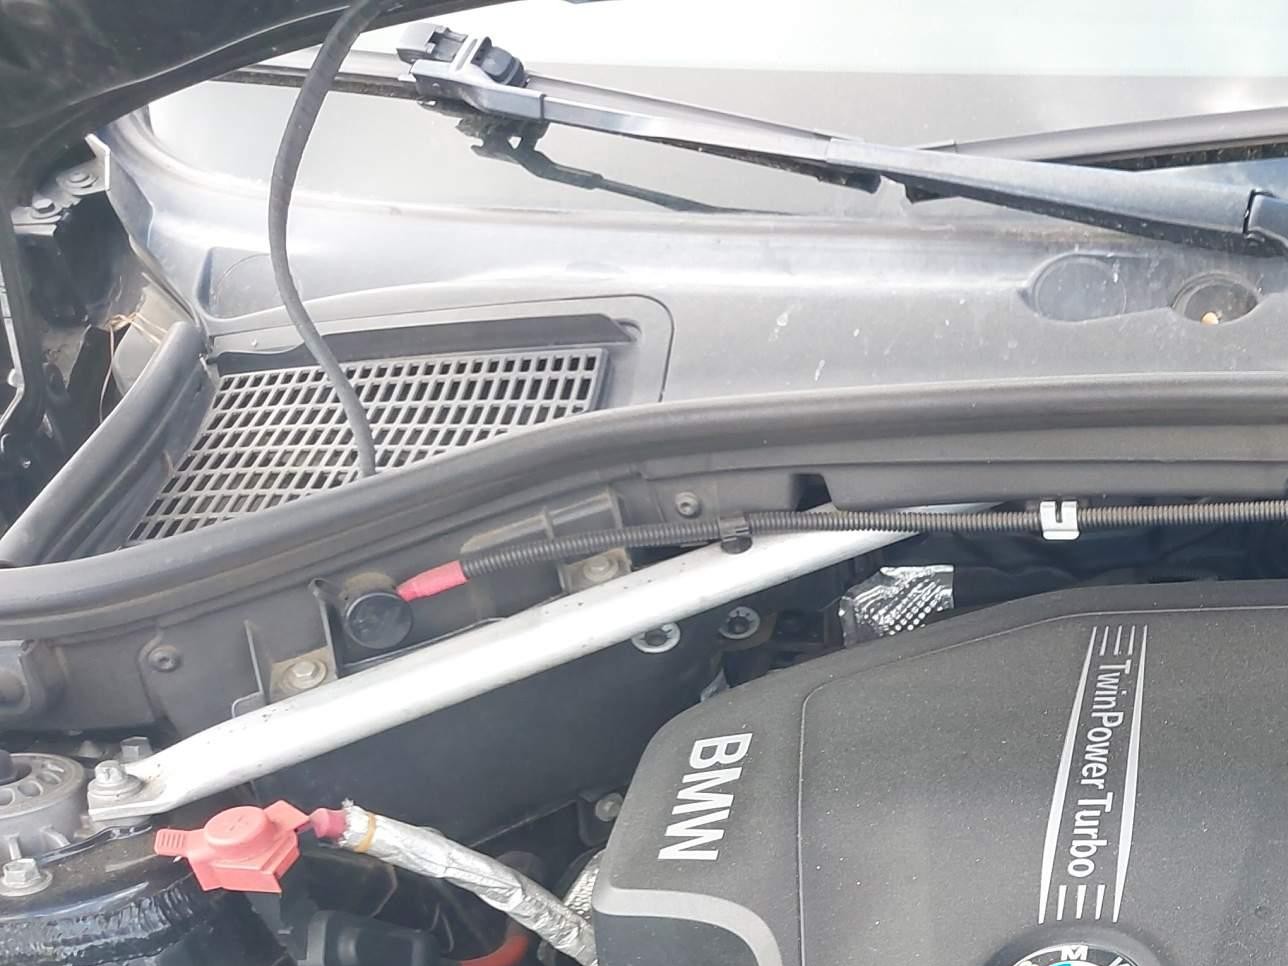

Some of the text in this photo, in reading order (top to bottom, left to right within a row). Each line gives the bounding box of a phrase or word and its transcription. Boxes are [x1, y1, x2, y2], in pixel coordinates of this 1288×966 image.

[657, 732, 753, 860] BMW
[1067, 659, 1131, 878] TwinPower Turbo
